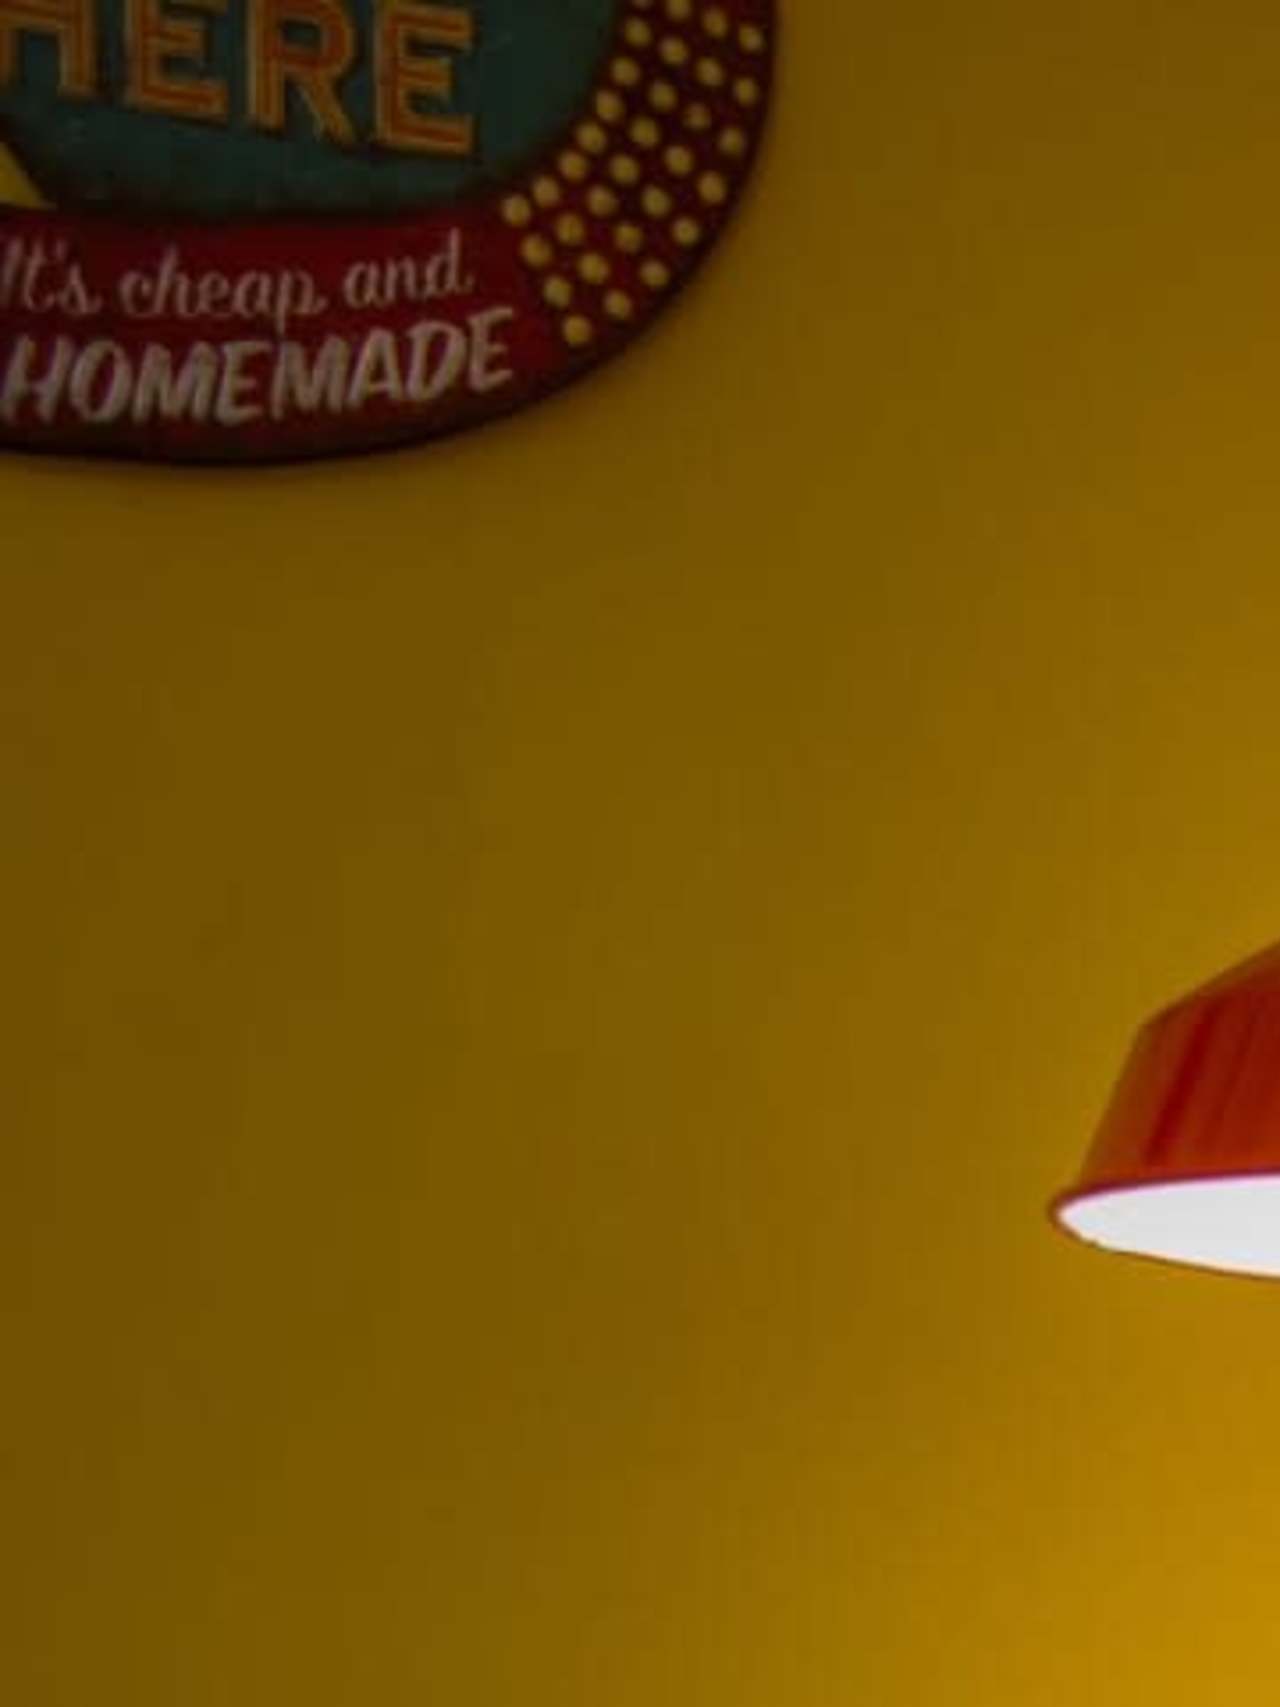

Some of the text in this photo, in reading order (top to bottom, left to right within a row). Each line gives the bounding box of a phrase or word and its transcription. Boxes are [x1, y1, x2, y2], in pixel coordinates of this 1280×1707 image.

[0, 227, 477, 334] It's cheap and
[0, 306, 515, 426] HOMEMADE
